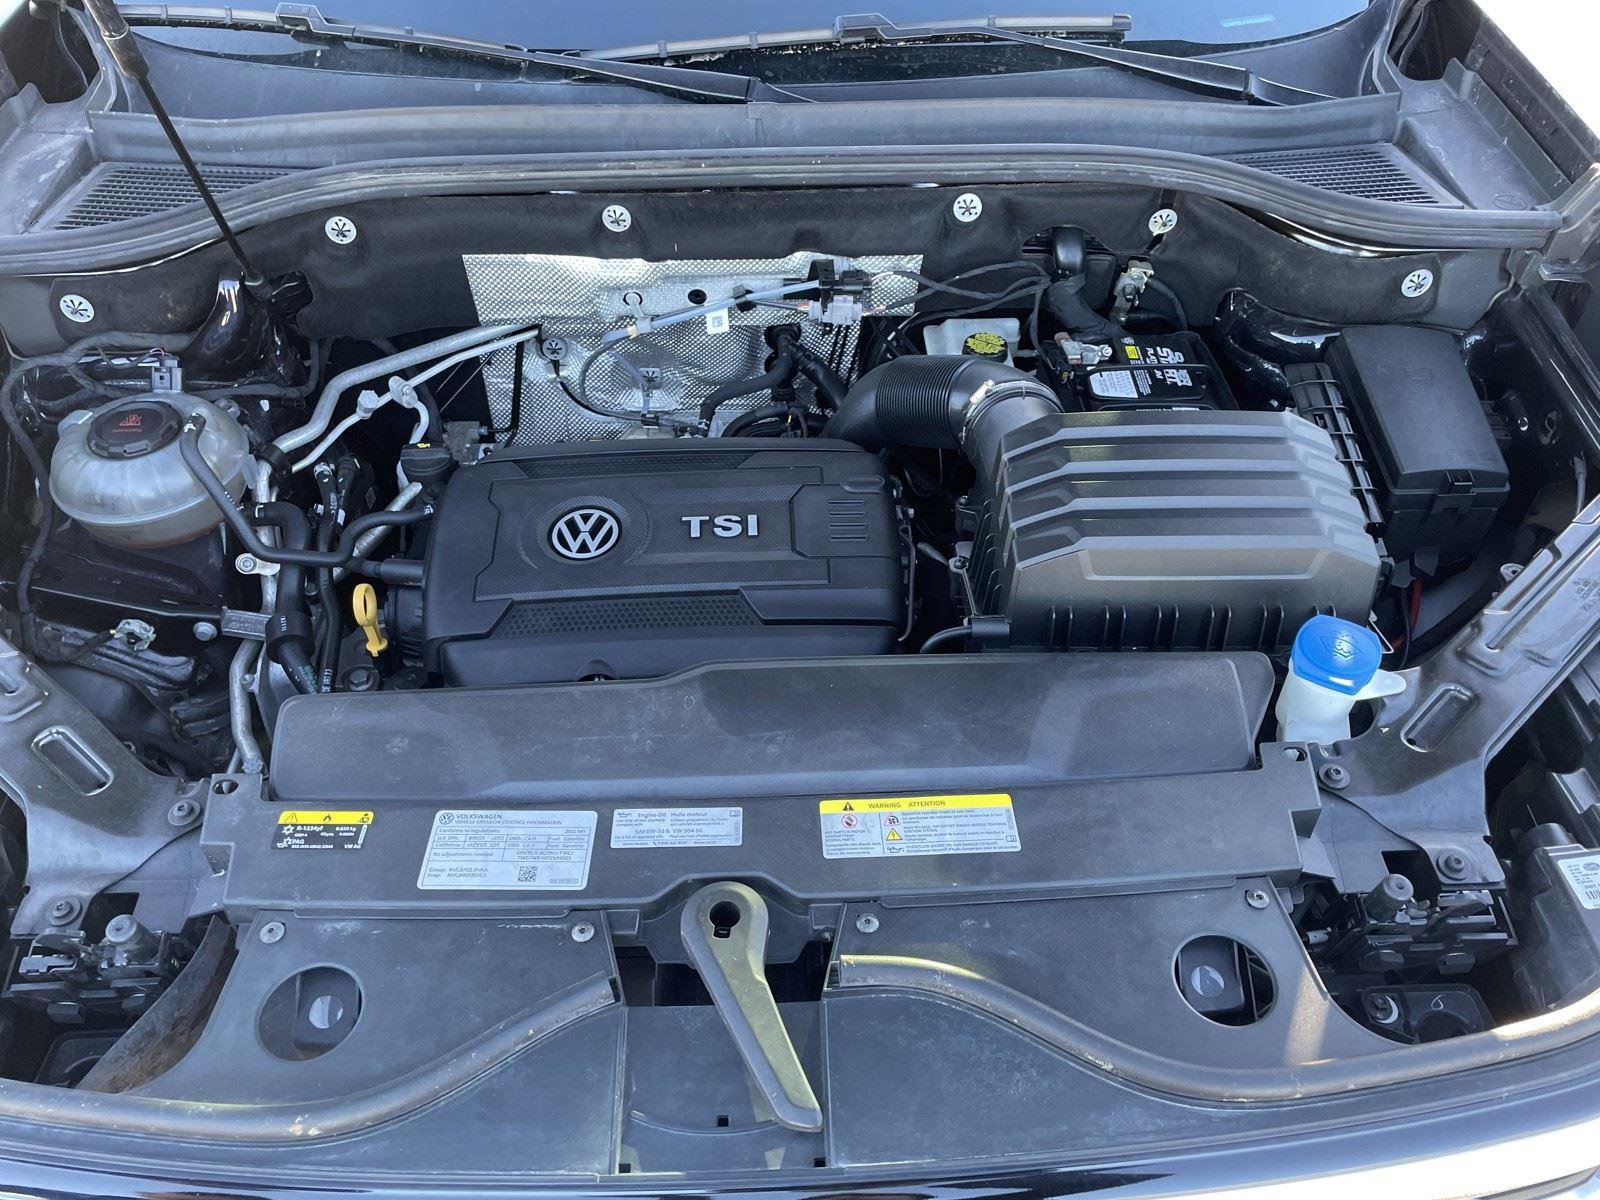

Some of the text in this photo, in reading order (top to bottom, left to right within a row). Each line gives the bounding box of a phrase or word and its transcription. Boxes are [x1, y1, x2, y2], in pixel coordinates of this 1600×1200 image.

[681, 514, 758, 538] TSI
[868, 800, 946, 810] WARNING ATTENTION
